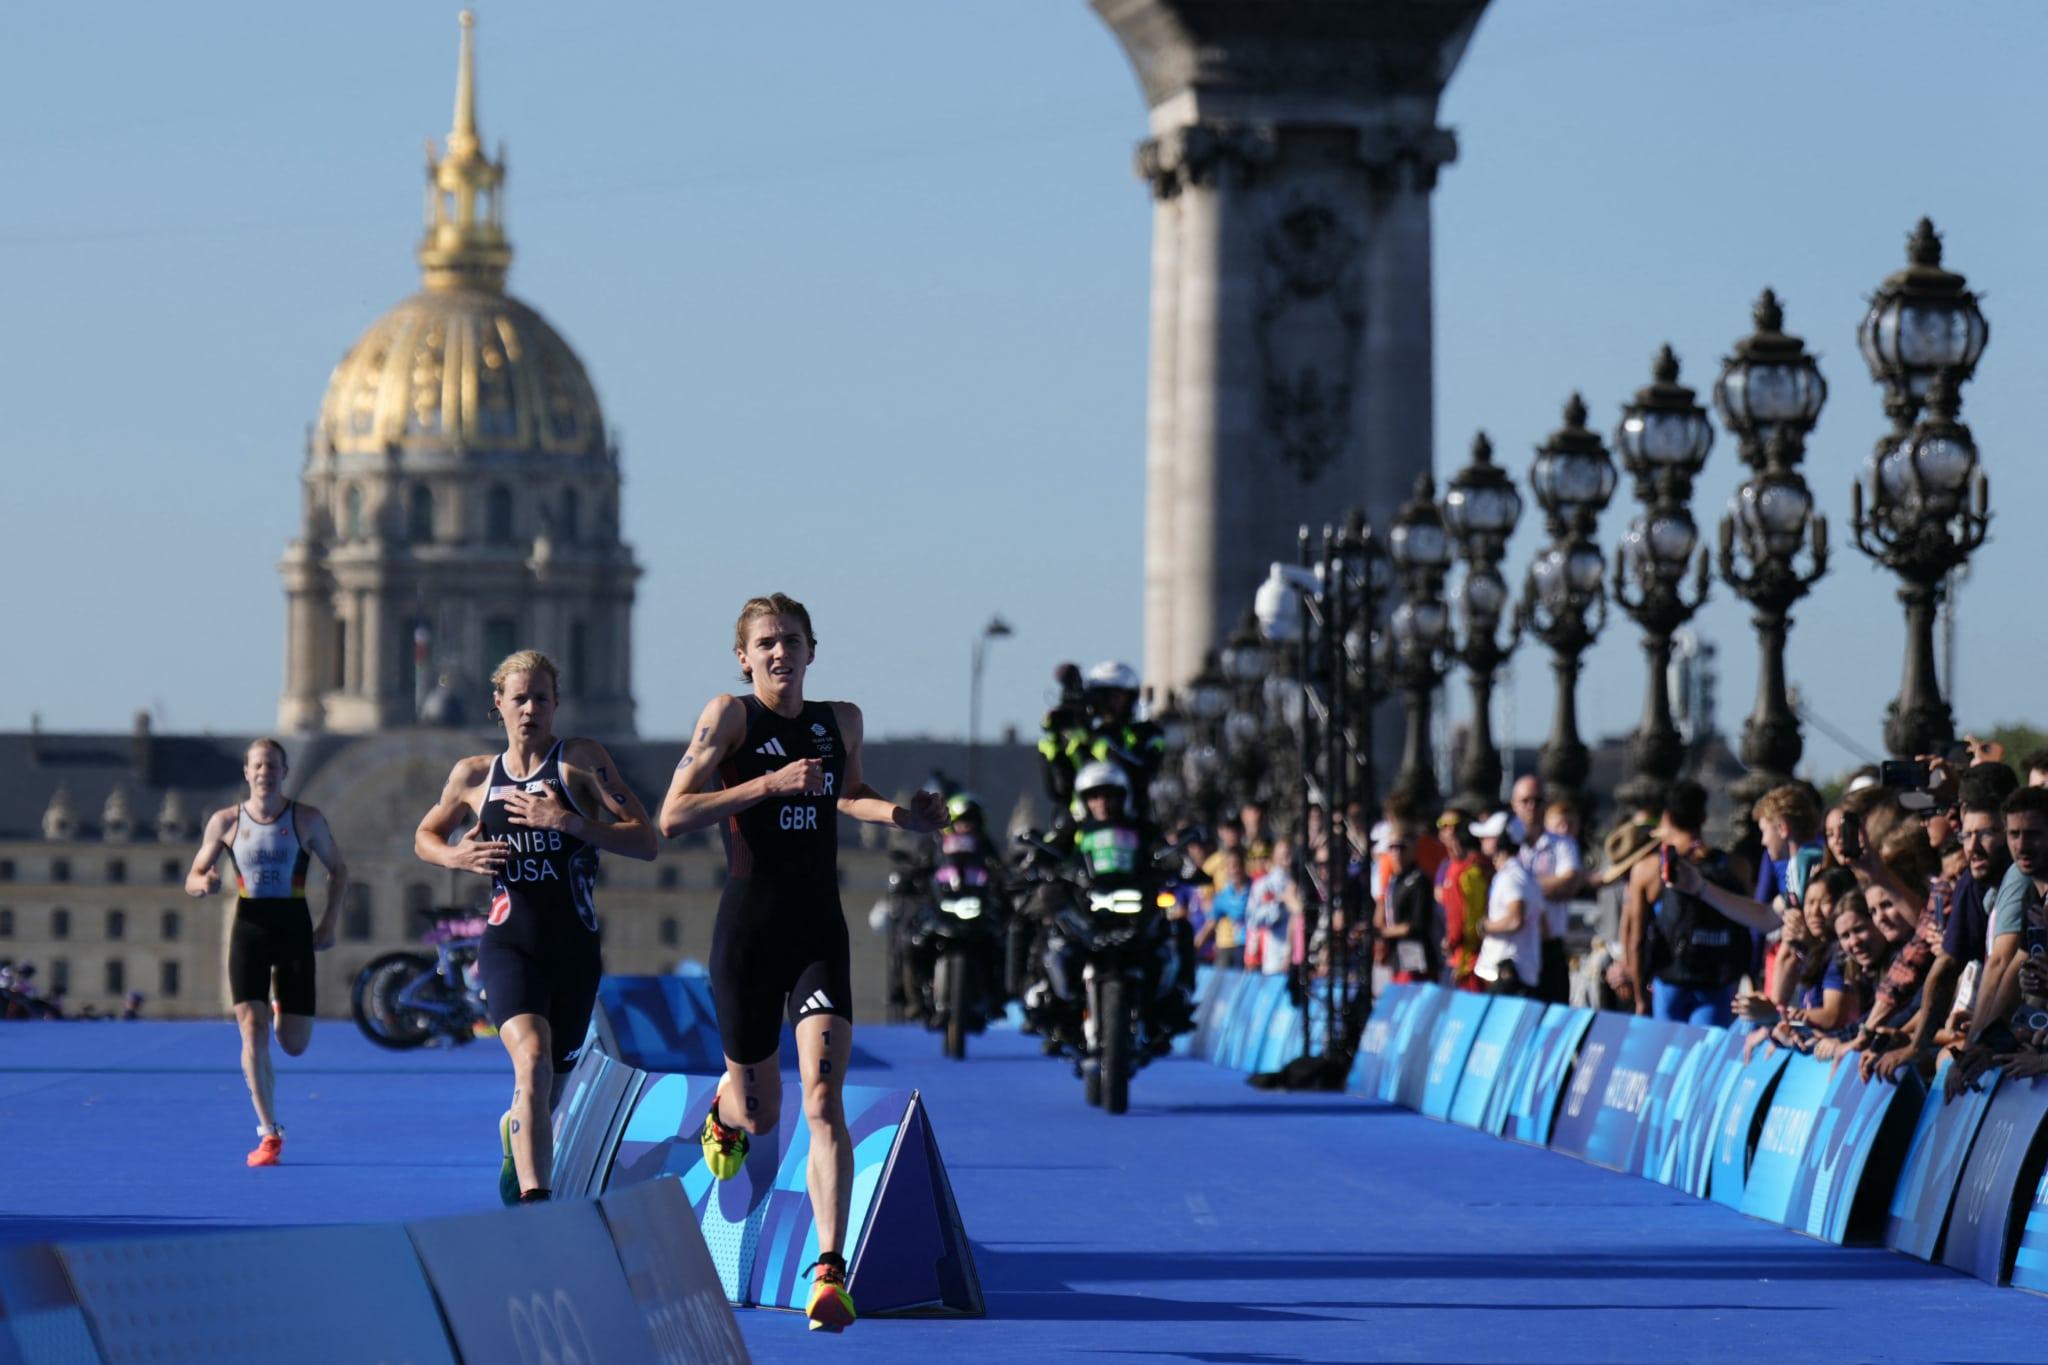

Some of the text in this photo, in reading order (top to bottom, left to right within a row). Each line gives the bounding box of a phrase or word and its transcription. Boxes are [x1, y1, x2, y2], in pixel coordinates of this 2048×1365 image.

[780, 805, 817, 830] GBR
[506, 858, 559, 882] USA
[511, 1119, 520, 1134] D
